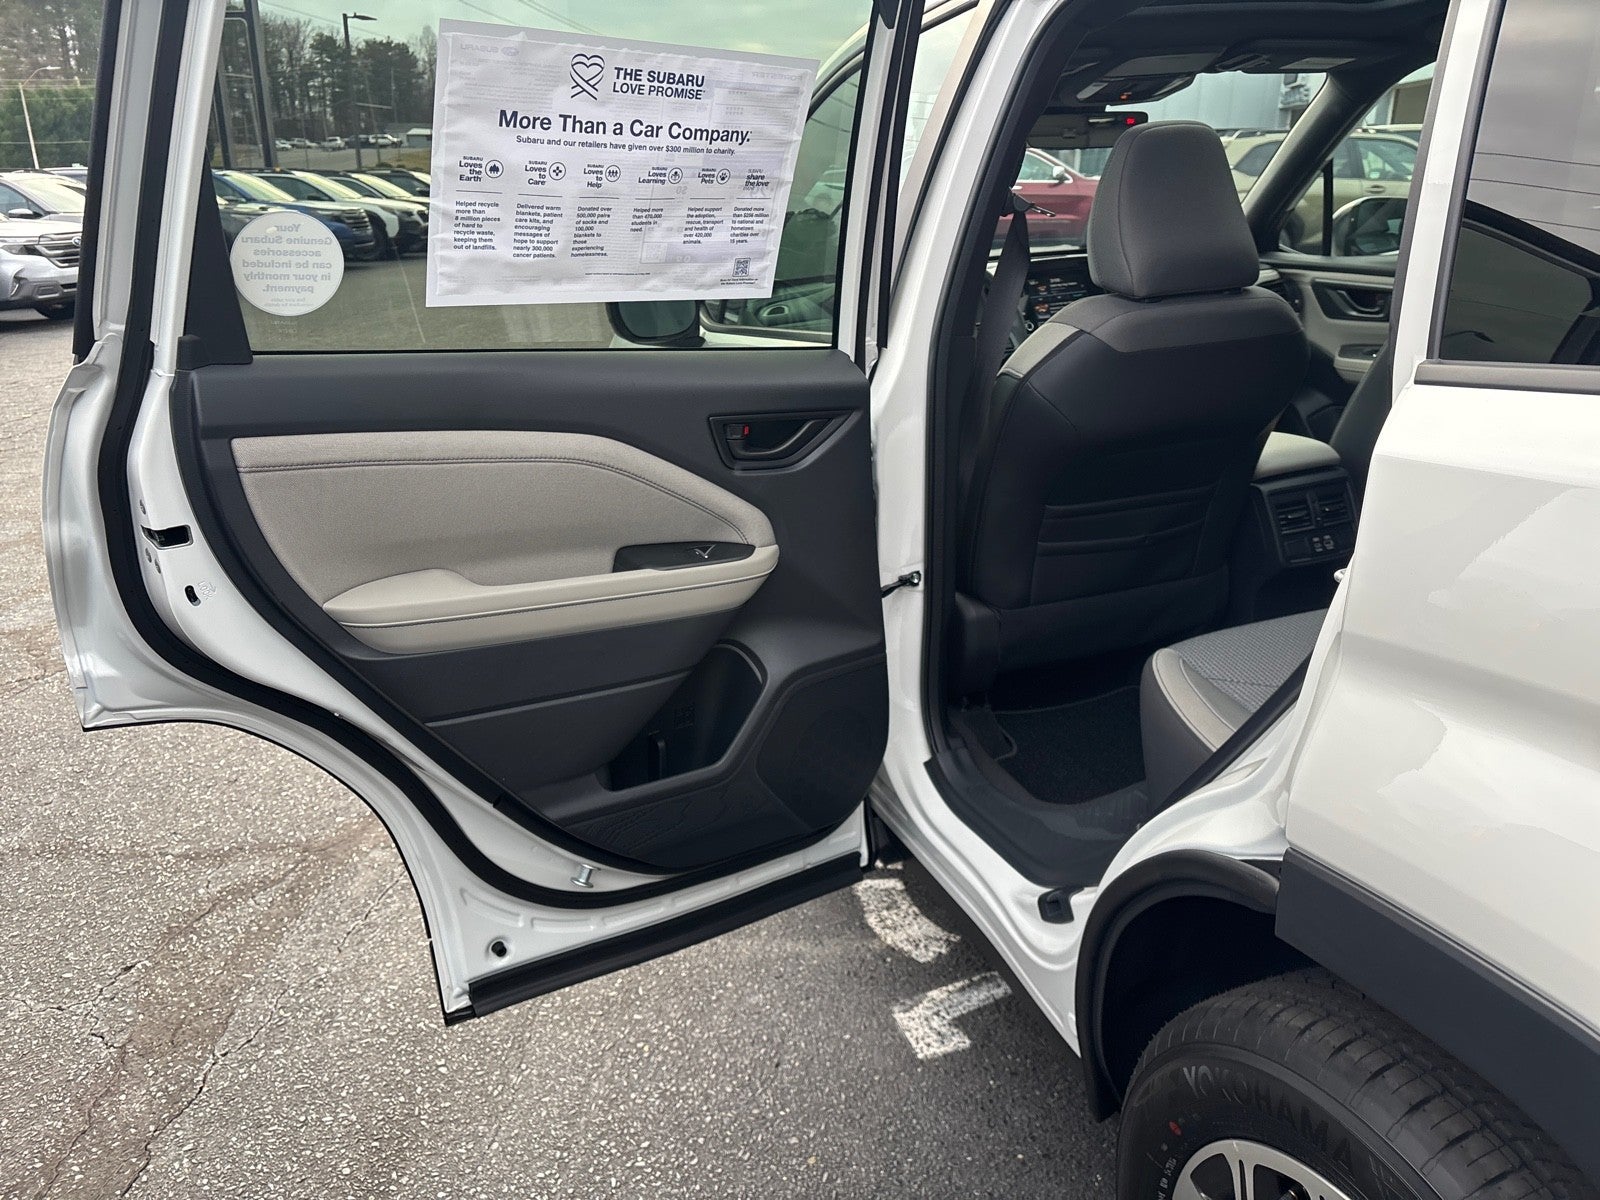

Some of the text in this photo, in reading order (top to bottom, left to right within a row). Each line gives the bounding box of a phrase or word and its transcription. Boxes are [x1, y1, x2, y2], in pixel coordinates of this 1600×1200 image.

[614, 67, 704, 87] THE SUBARU
[613, 82, 703, 100] LOVE PROMISE
[498, 110, 750, 146] More Than a Car Company.
[516, 135, 544, 145] Subaru
[546, 137, 561, 146] and
[578, 139, 607, 149] retailers
[609, 141, 626, 150] have
[628, 142, 647, 152] given
[665, 144, 682, 153] $300
[683, 146, 704, 154] million
[714, 147, 736, 156] charity.
